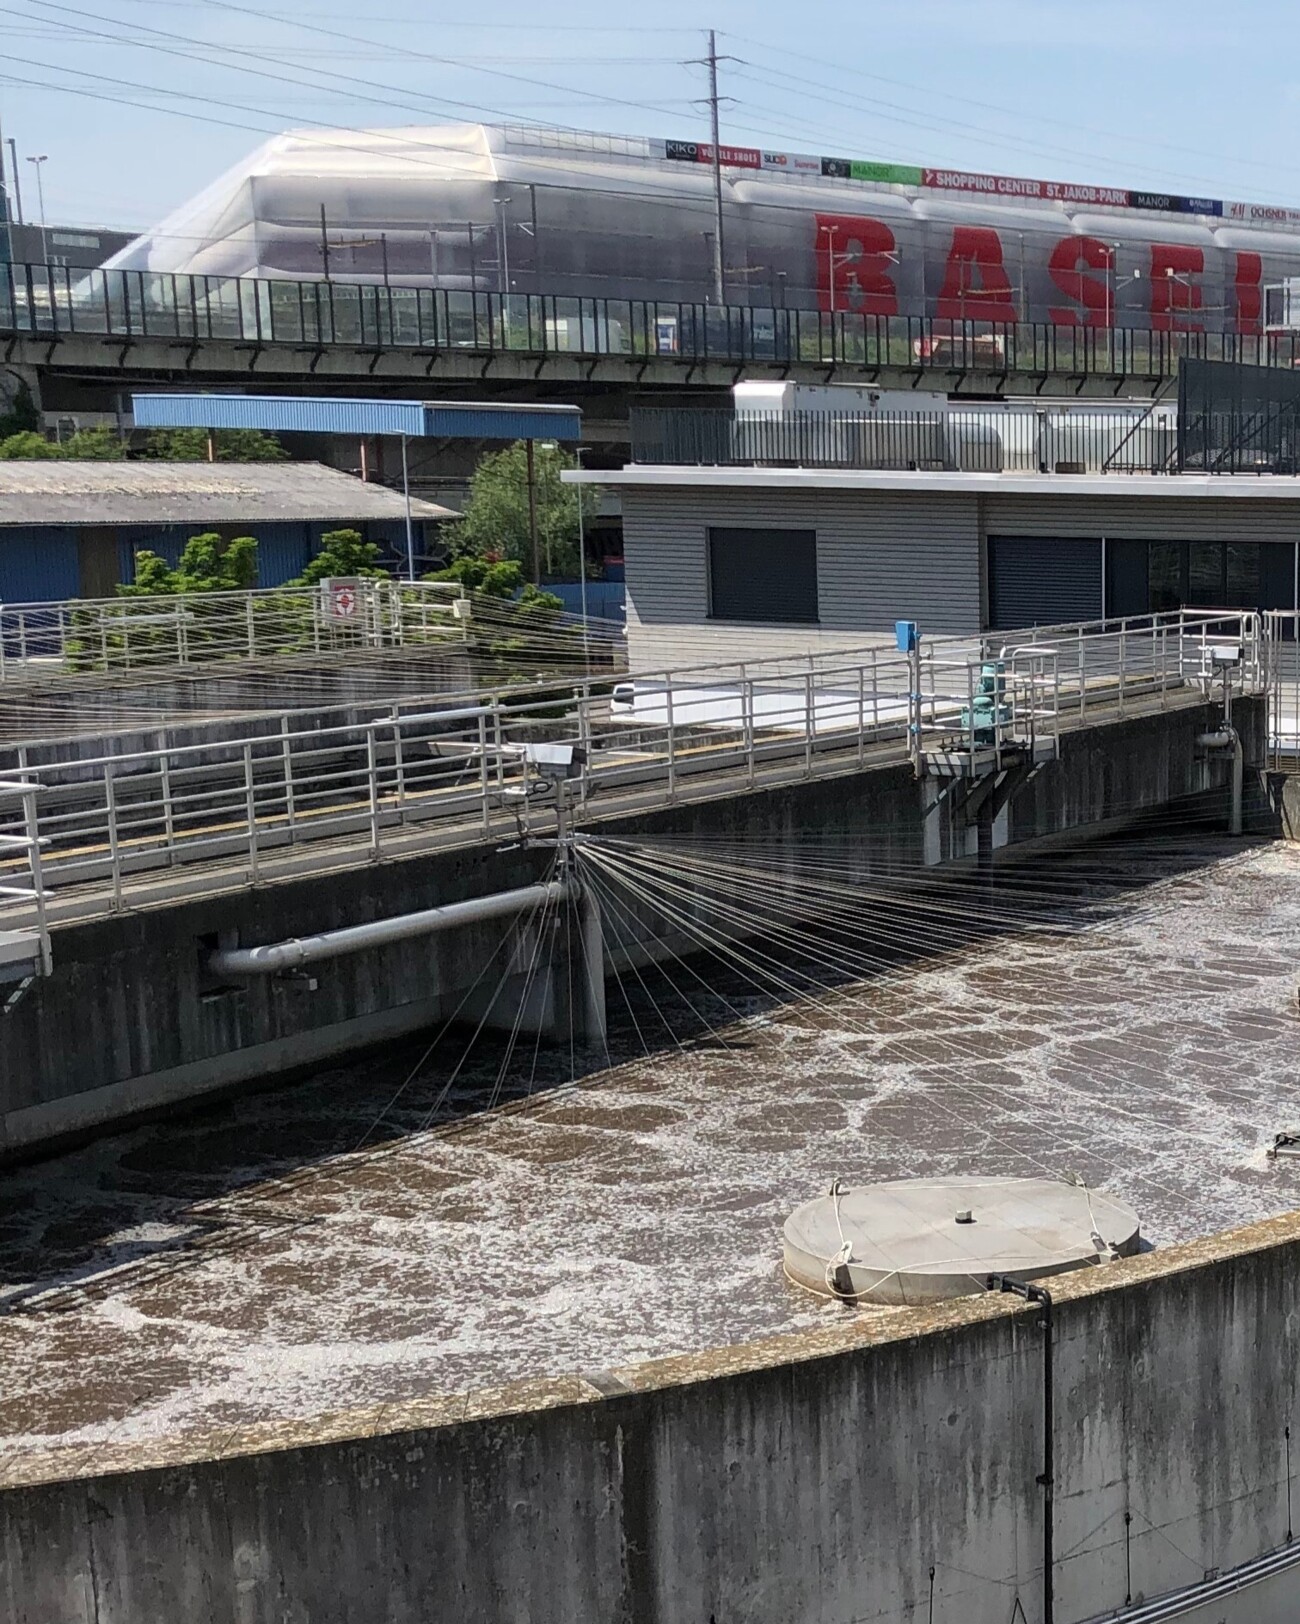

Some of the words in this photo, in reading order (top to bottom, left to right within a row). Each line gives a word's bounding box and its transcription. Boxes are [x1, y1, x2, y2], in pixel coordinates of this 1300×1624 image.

[666, 142, 697, 155] KIKO
[936, 172, 995, 191] SHOPPING
[997, 180, 1041, 197] CENTER
[1046, 186, 1062, 198] ST.
[1063, 187, 1127, 205] JAKOB-PARK
[1137, 194, 1170, 208] MANOR
